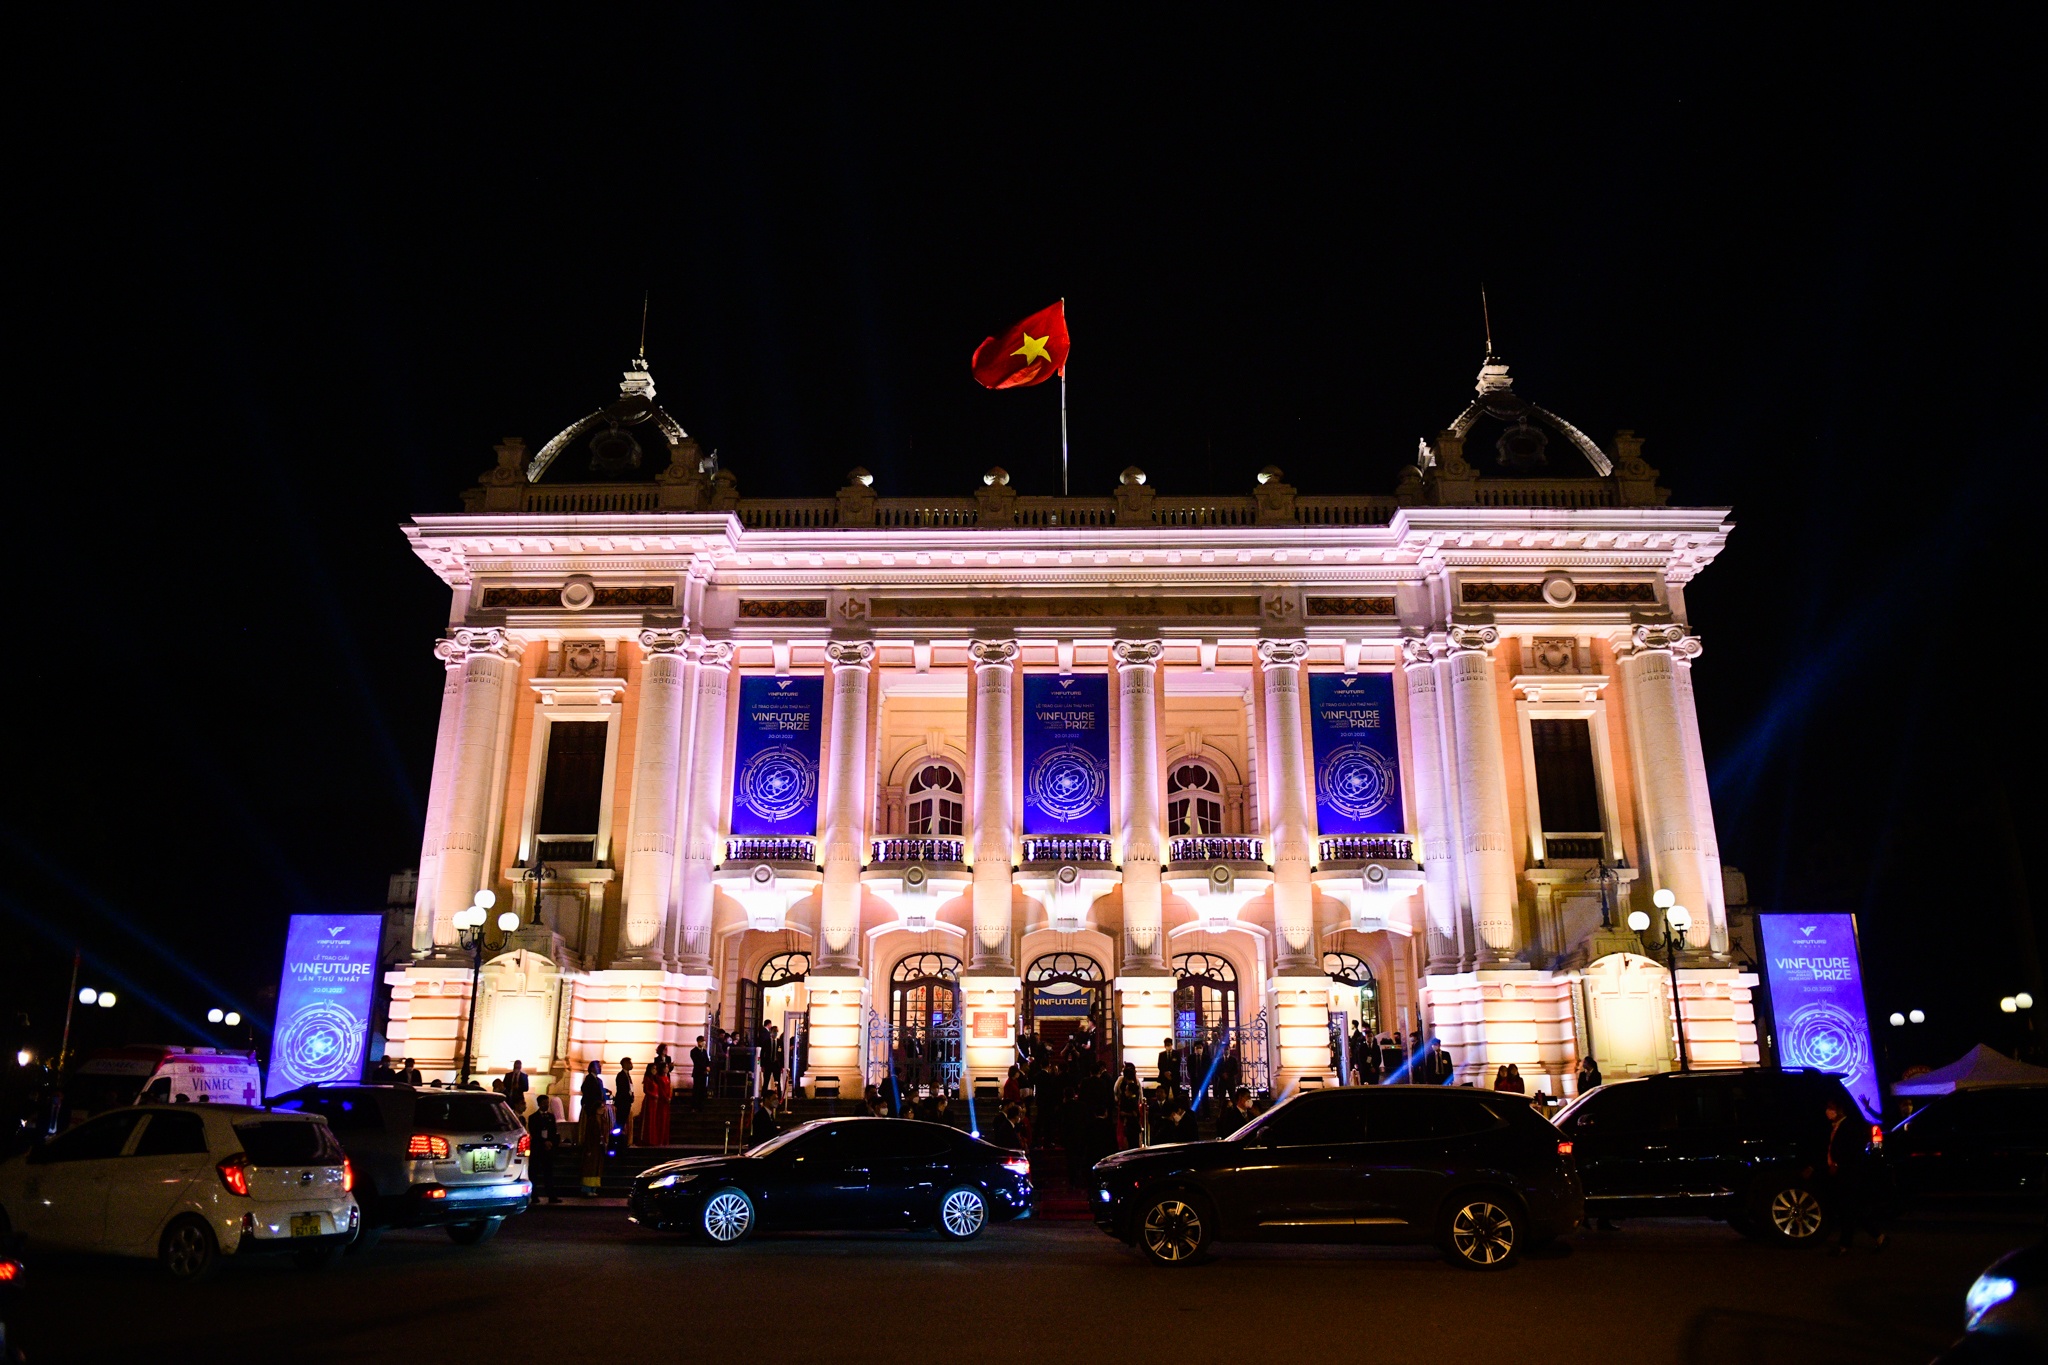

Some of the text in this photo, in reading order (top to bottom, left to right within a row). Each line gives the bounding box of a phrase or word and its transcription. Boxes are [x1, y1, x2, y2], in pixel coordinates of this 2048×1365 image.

[752, 713, 810, 721] VINFUTURE
[1036, 712, 1095, 720] VINFUTURE
[1320, 710, 1380, 719] VINFUTURE
[779, 721, 810, 731] PRIZE
[1065, 720, 1095, 729] PRIZE
[1350, 719, 1380, 728] PRIZE
[1775, 957, 1851, 969] VINFUTURE
[290, 962, 371, 975] VINFUTURE
[1813, 969, 1852, 980] PRIZE
[1033, 998, 1088, 1006] VINFUTURE
[192, 1077, 234, 1091] VINMEC
